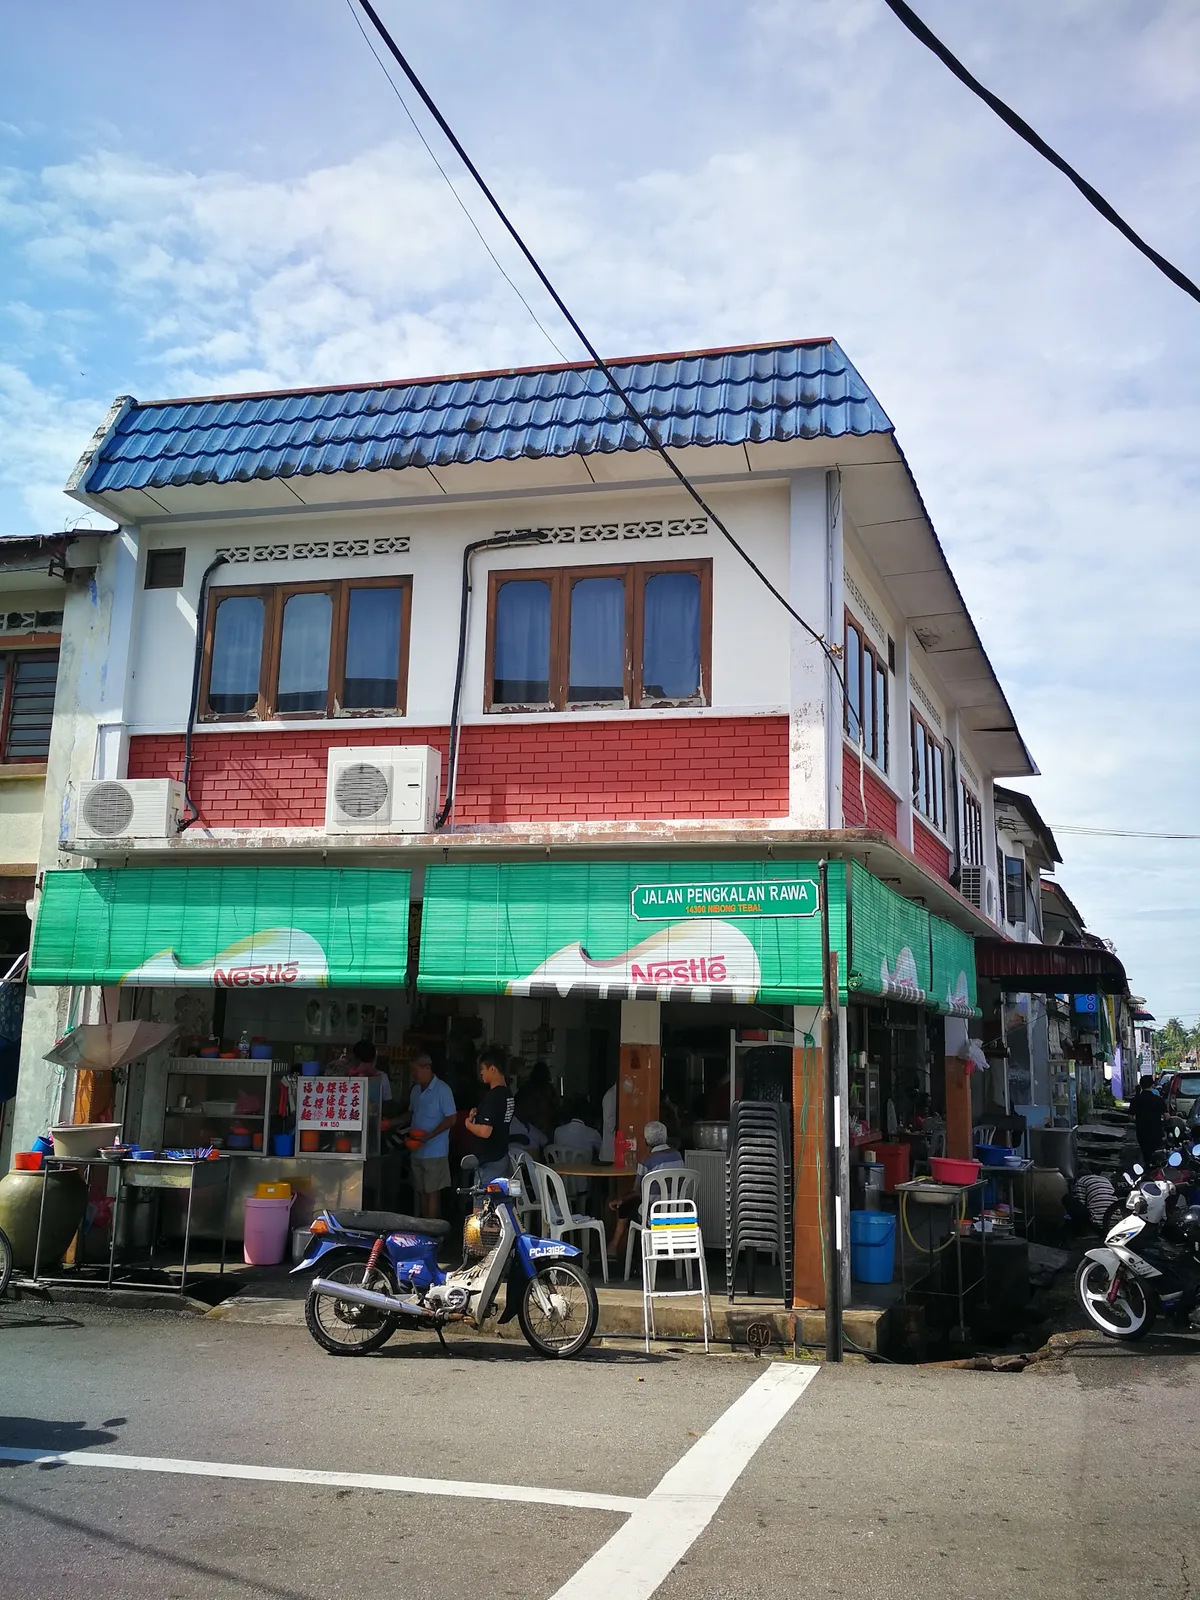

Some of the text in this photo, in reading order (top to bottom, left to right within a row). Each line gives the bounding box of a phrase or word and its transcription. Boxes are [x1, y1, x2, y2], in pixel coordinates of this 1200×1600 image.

[642, 884, 809, 905] JALAN PENGKALAN RAWA
[707, 904, 736, 913] NIBONG
[737, 903, 763, 912] TEBAL
[213, 961, 299, 988] Nestlé
[631, 955, 727, 986] Nestlé
